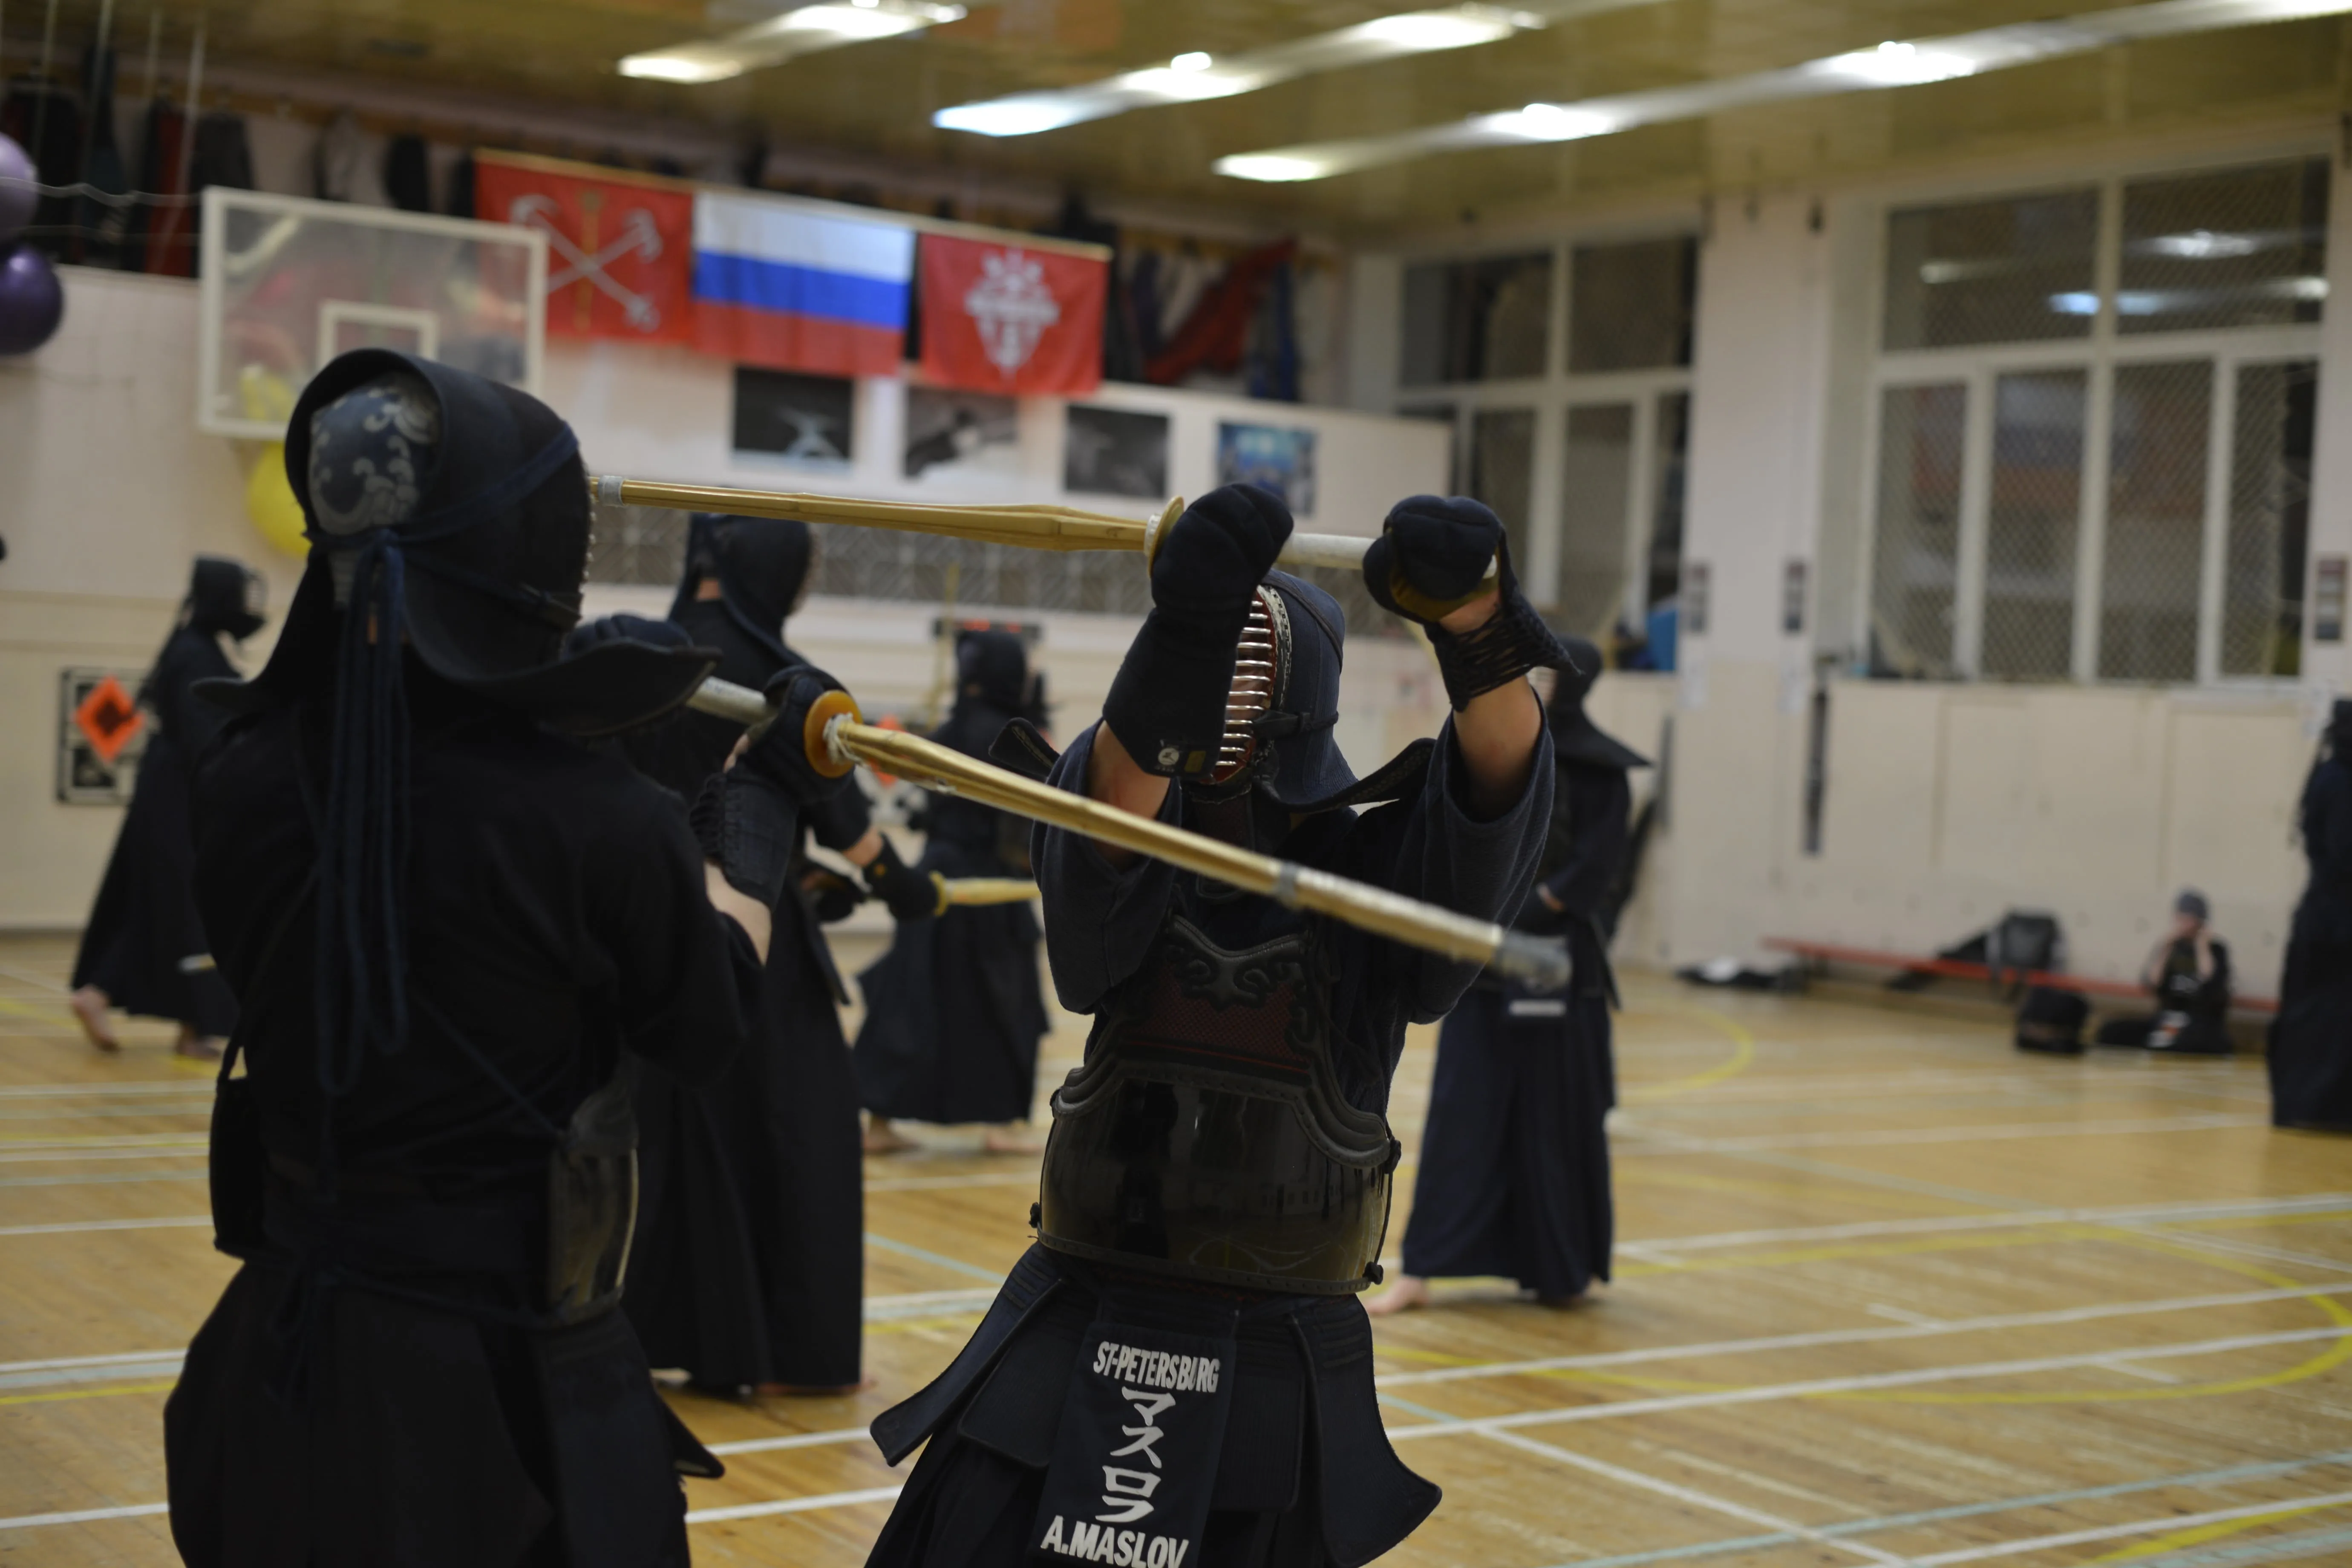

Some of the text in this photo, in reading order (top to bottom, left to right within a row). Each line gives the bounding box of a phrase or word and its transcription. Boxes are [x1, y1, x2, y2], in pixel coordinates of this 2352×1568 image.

[1093, 1341, 1220, 1392] ST-PETERSBURG
[1095, 1386, 1176, 1522] マスロフ
[1040, 1515, 1189, 1568] A.MASLOV
